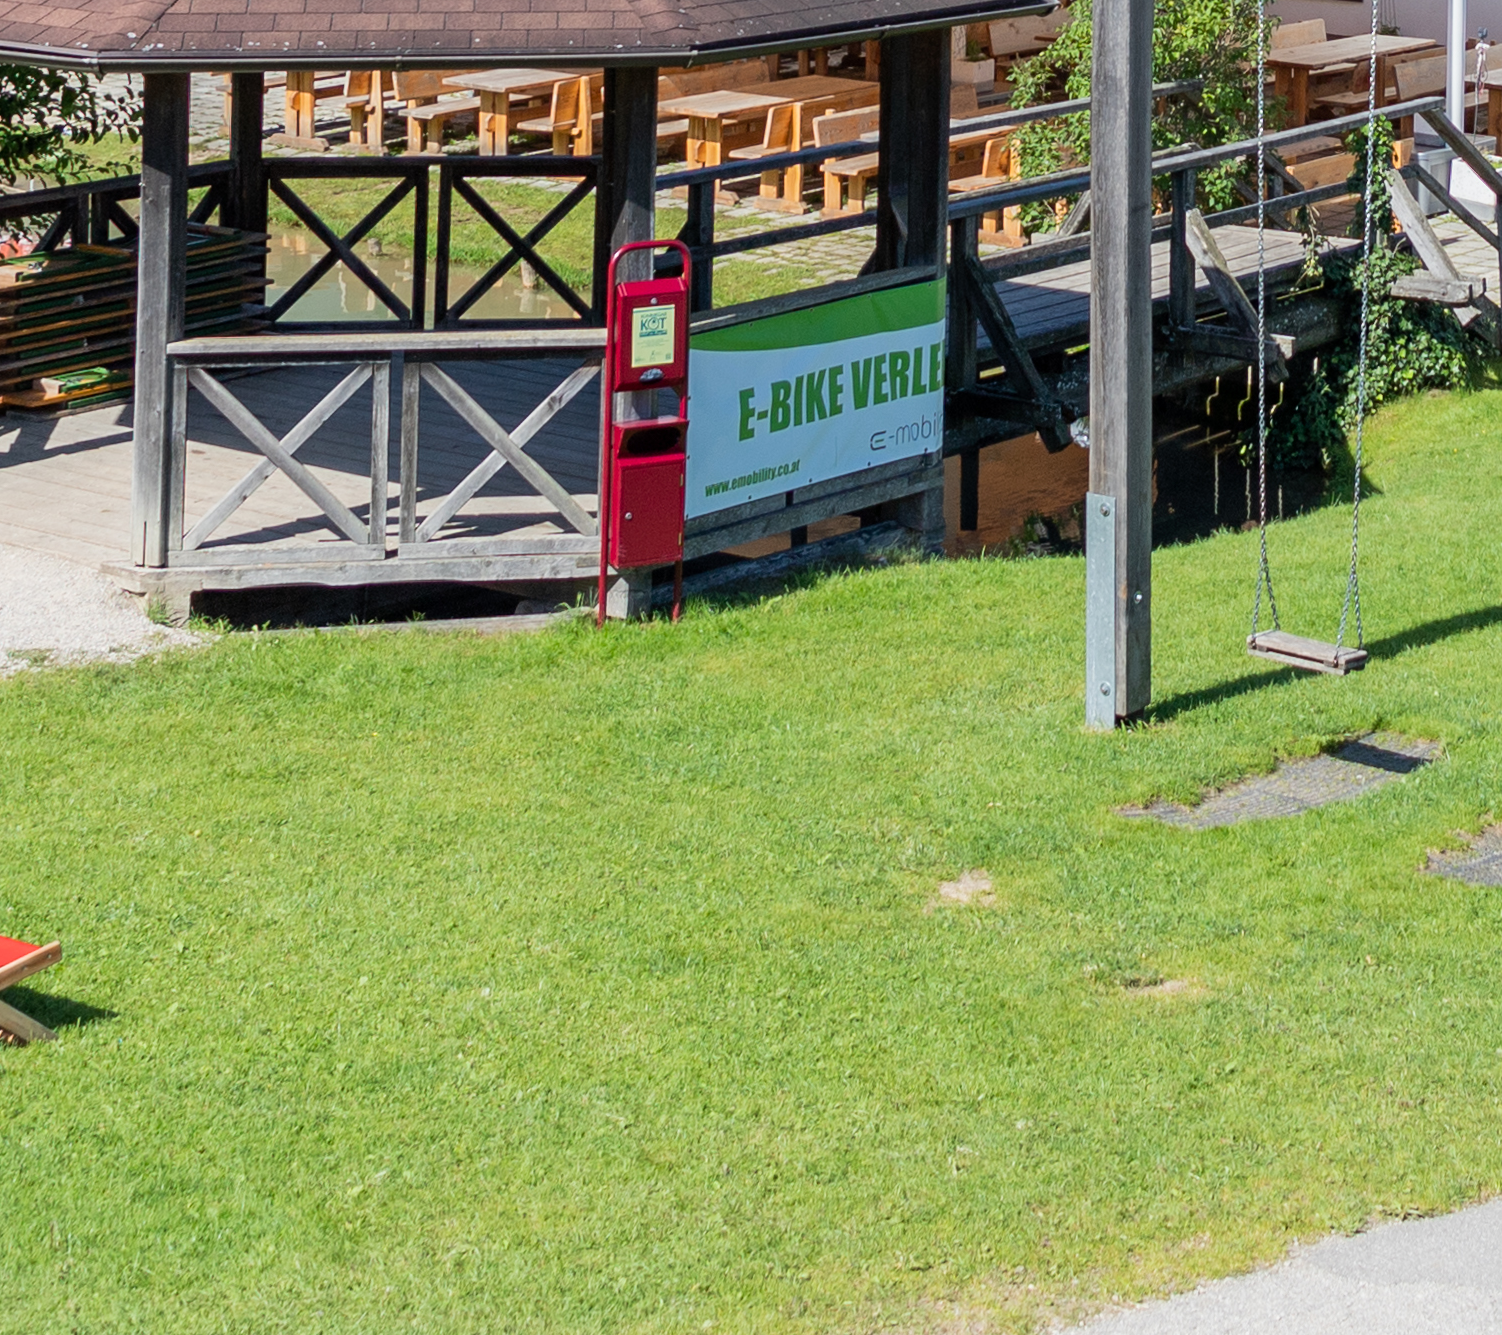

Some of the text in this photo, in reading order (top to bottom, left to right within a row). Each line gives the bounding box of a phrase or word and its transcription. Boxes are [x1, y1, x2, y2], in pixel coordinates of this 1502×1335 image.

[641, 317, 667, 331] KOT
[738, 364, 844, 443] E-BIKE
[705, 458, 801, 498] www.emobility.co.at
